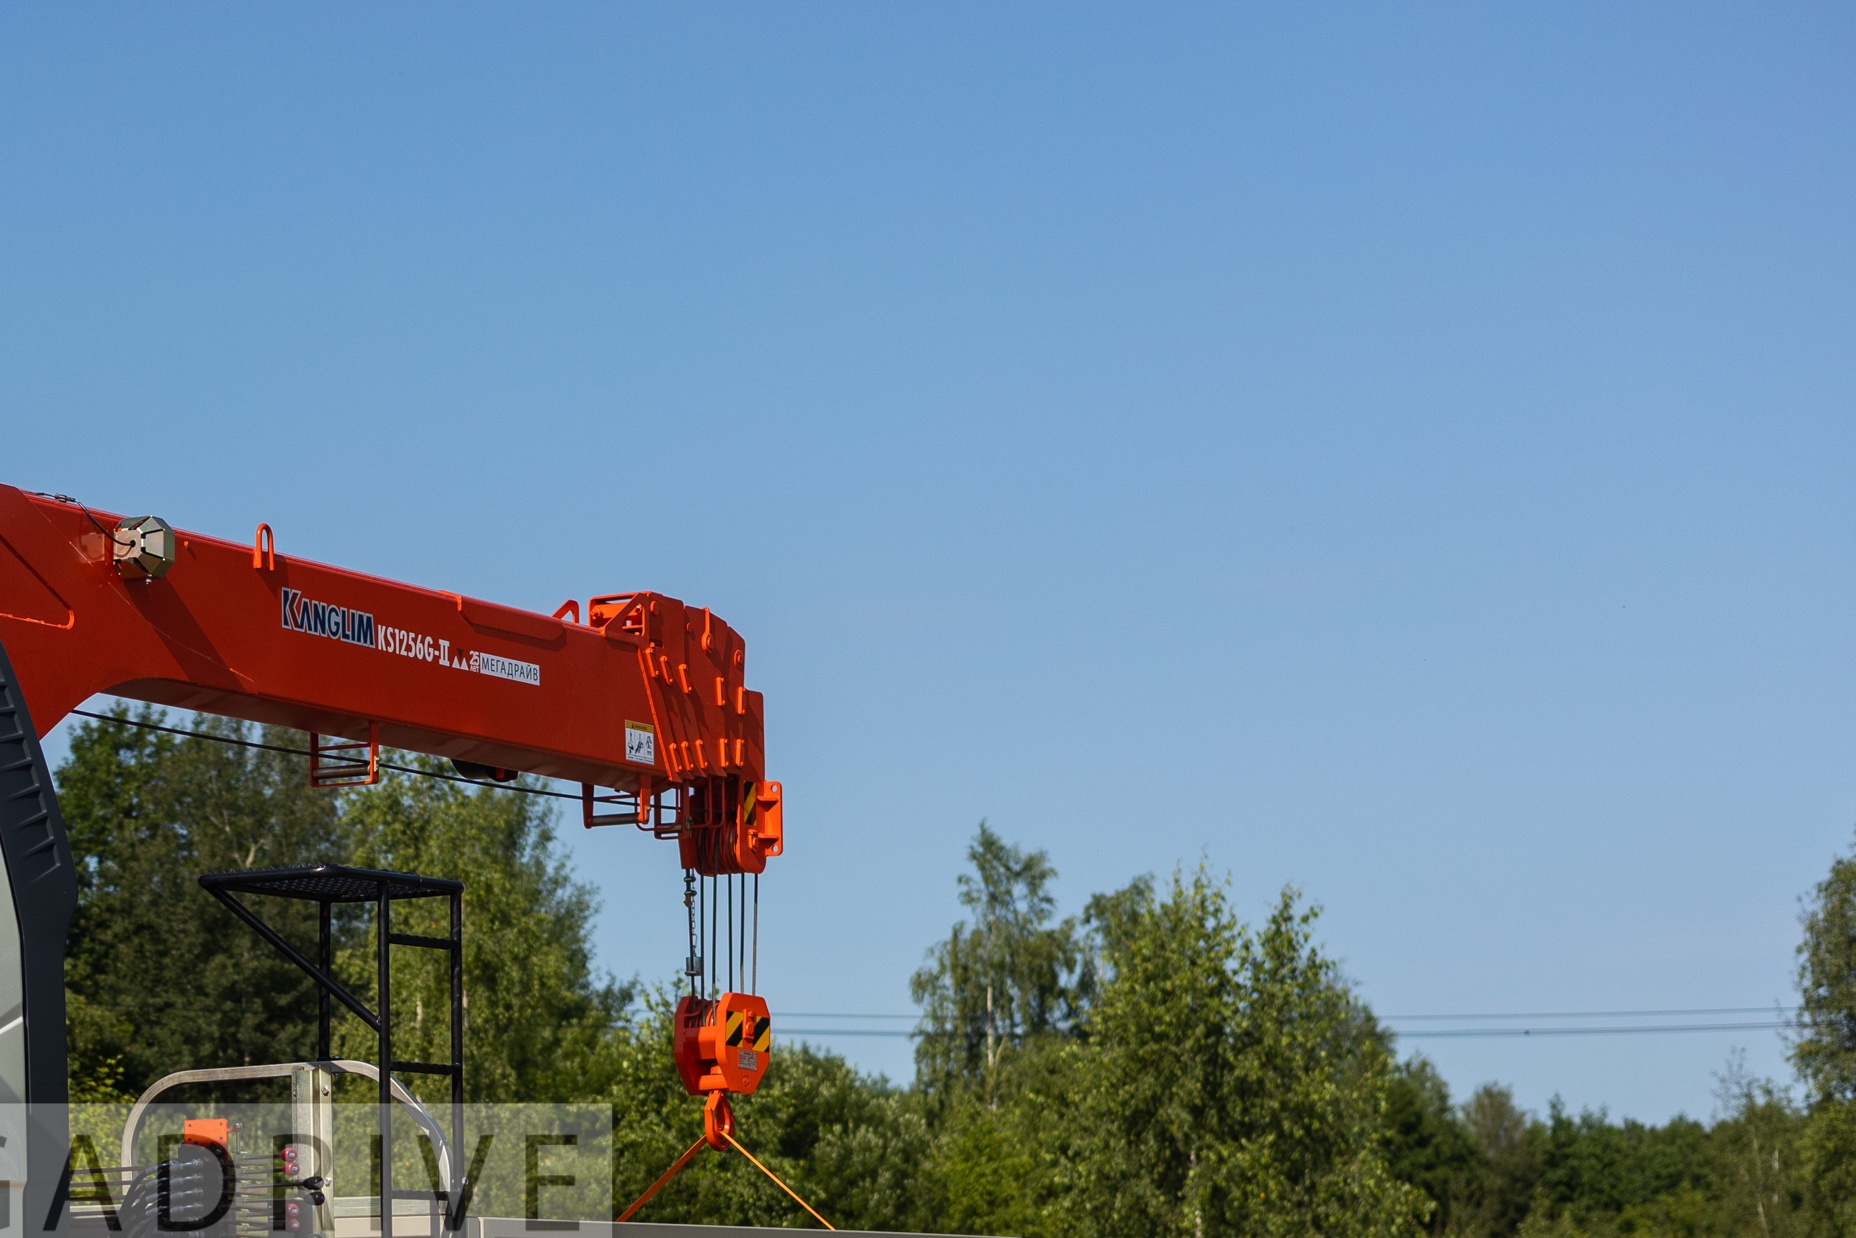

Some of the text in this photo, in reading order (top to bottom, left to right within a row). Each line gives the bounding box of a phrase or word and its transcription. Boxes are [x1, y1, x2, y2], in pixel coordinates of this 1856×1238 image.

[281, 586, 375, 648] KANGLIM
[469, 650, 480, 666] 25
[481, 655, 539, 682] МЕГАДРАЙВ
